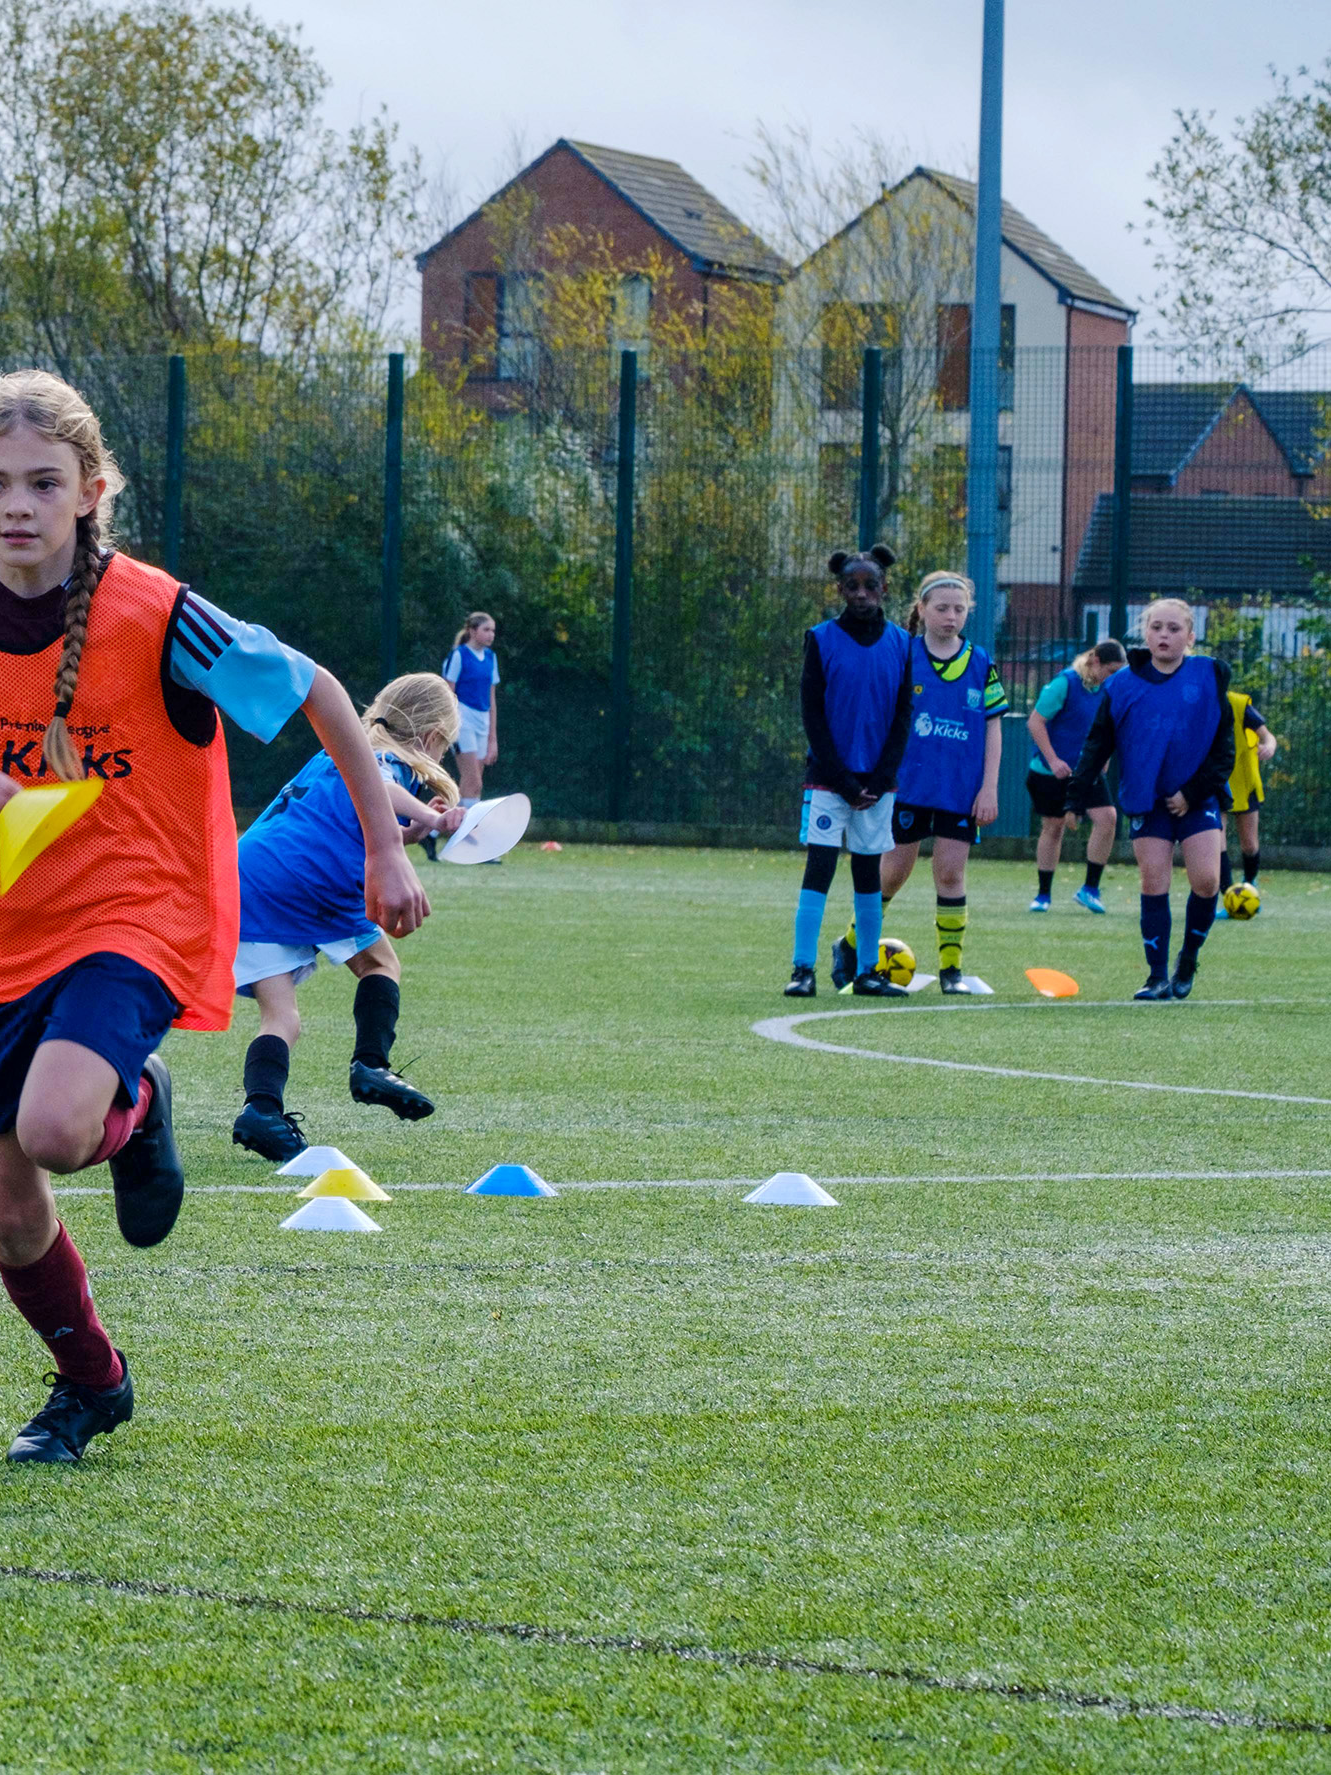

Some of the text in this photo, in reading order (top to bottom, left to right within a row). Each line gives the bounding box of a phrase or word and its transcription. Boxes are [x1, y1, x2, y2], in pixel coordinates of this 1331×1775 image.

[0, 717, 110, 738] Premie eague
[934, 723, 969, 740] Kicks
[1, 740, 133, 779] Kiks
